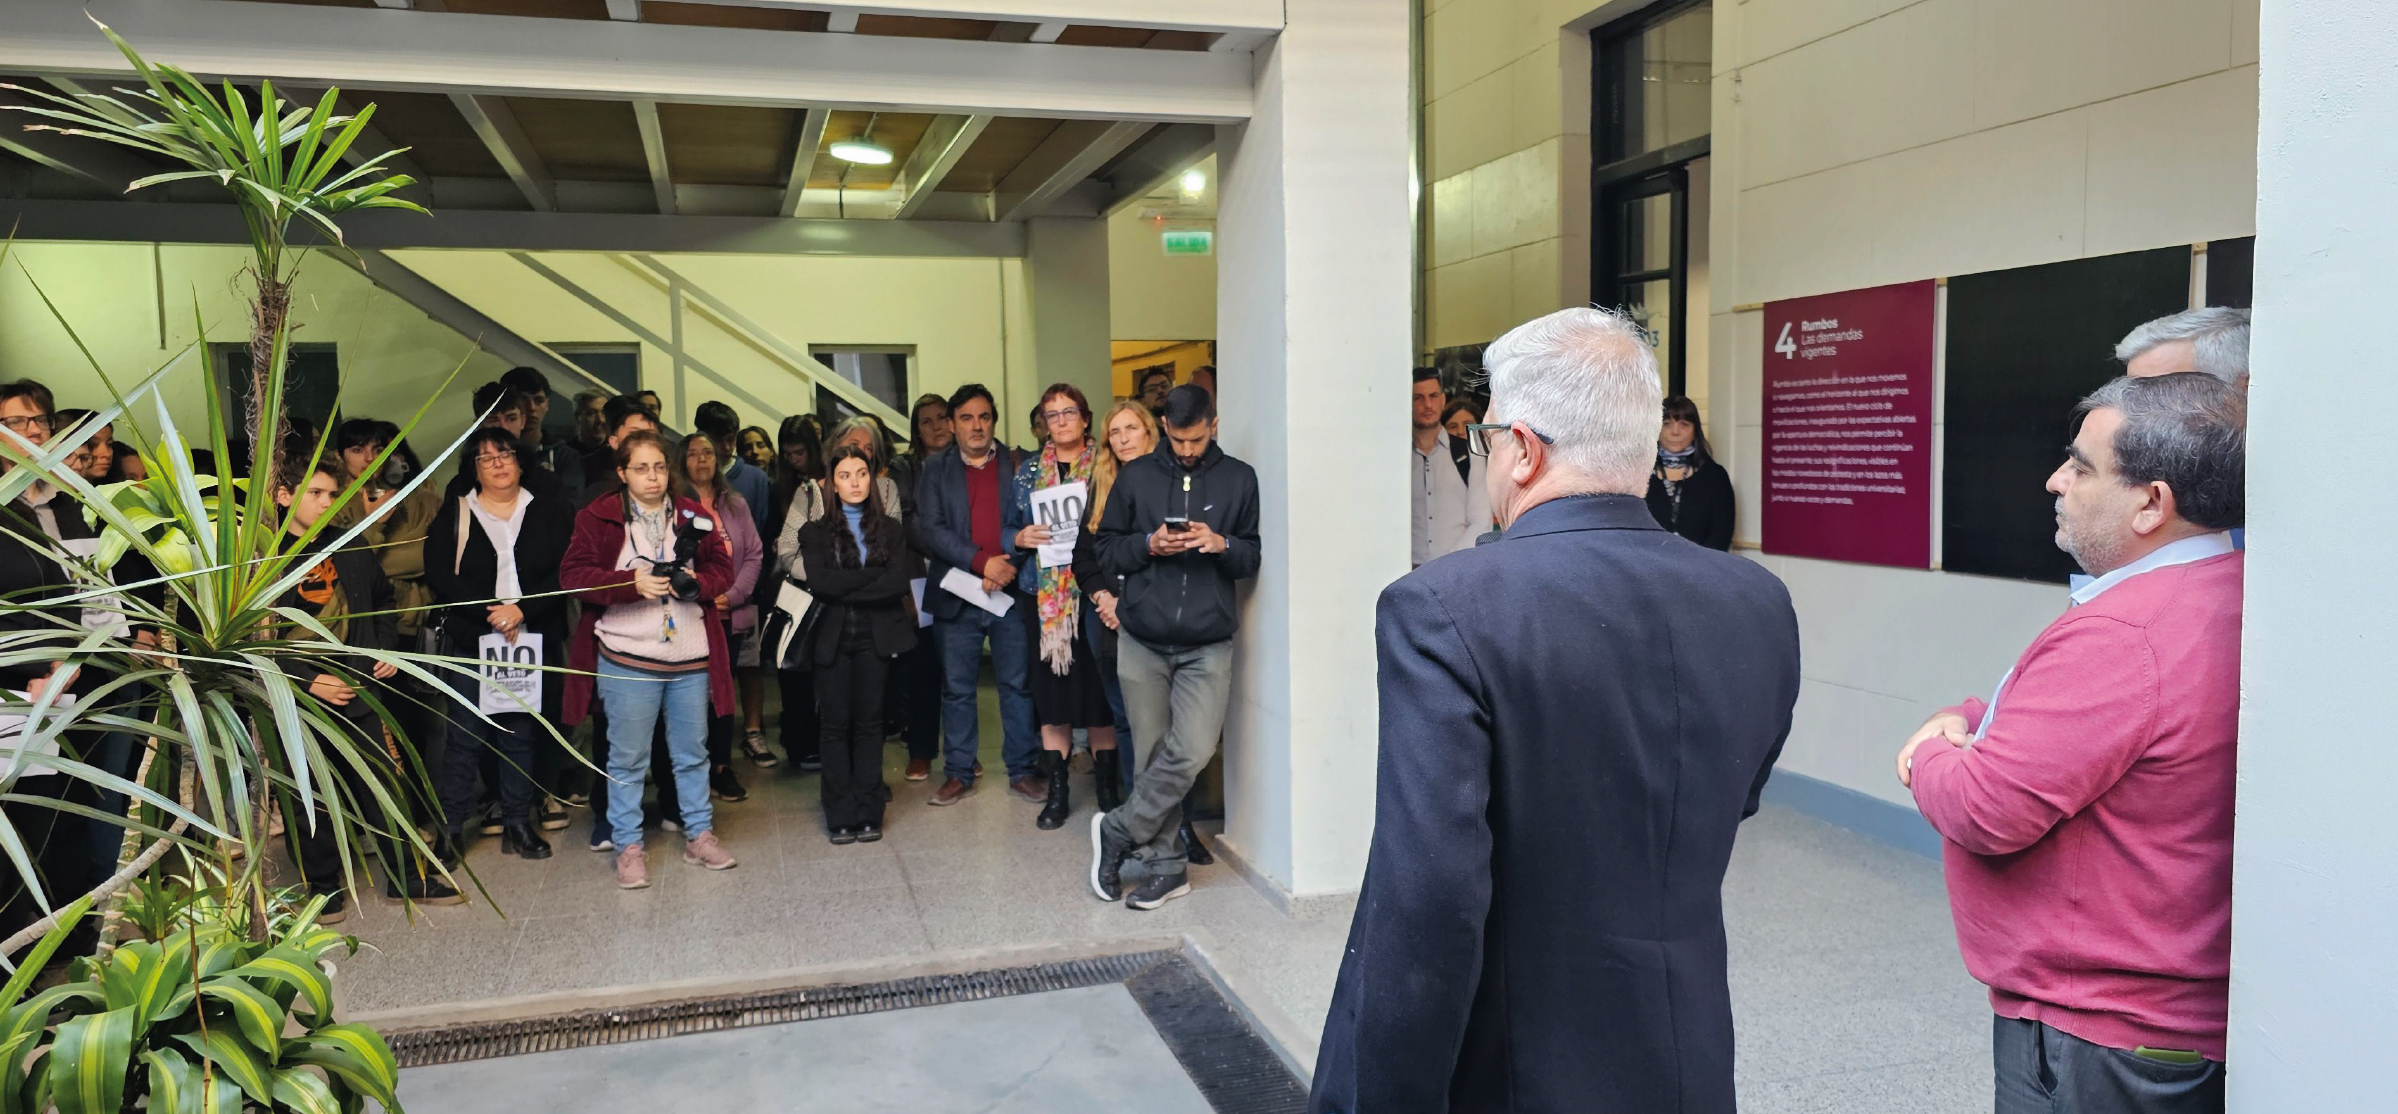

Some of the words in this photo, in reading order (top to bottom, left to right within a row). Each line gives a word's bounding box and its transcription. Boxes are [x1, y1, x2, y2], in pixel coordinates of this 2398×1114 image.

[1167, 237, 1207, 247] SALIDA
[1801, 319, 1838, 332] Rumbos
[1774, 322, 1797, 359] 4
[1801, 334, 1816, 346] Las
[1816, 328, 1863, 343] demandas
[1801, 346, 1837, 360] vigentes
[1039, 496, 1084, 528] NO
[1060, 520, 1078, 529] VETO
[486, 645, 536, 678] NO
